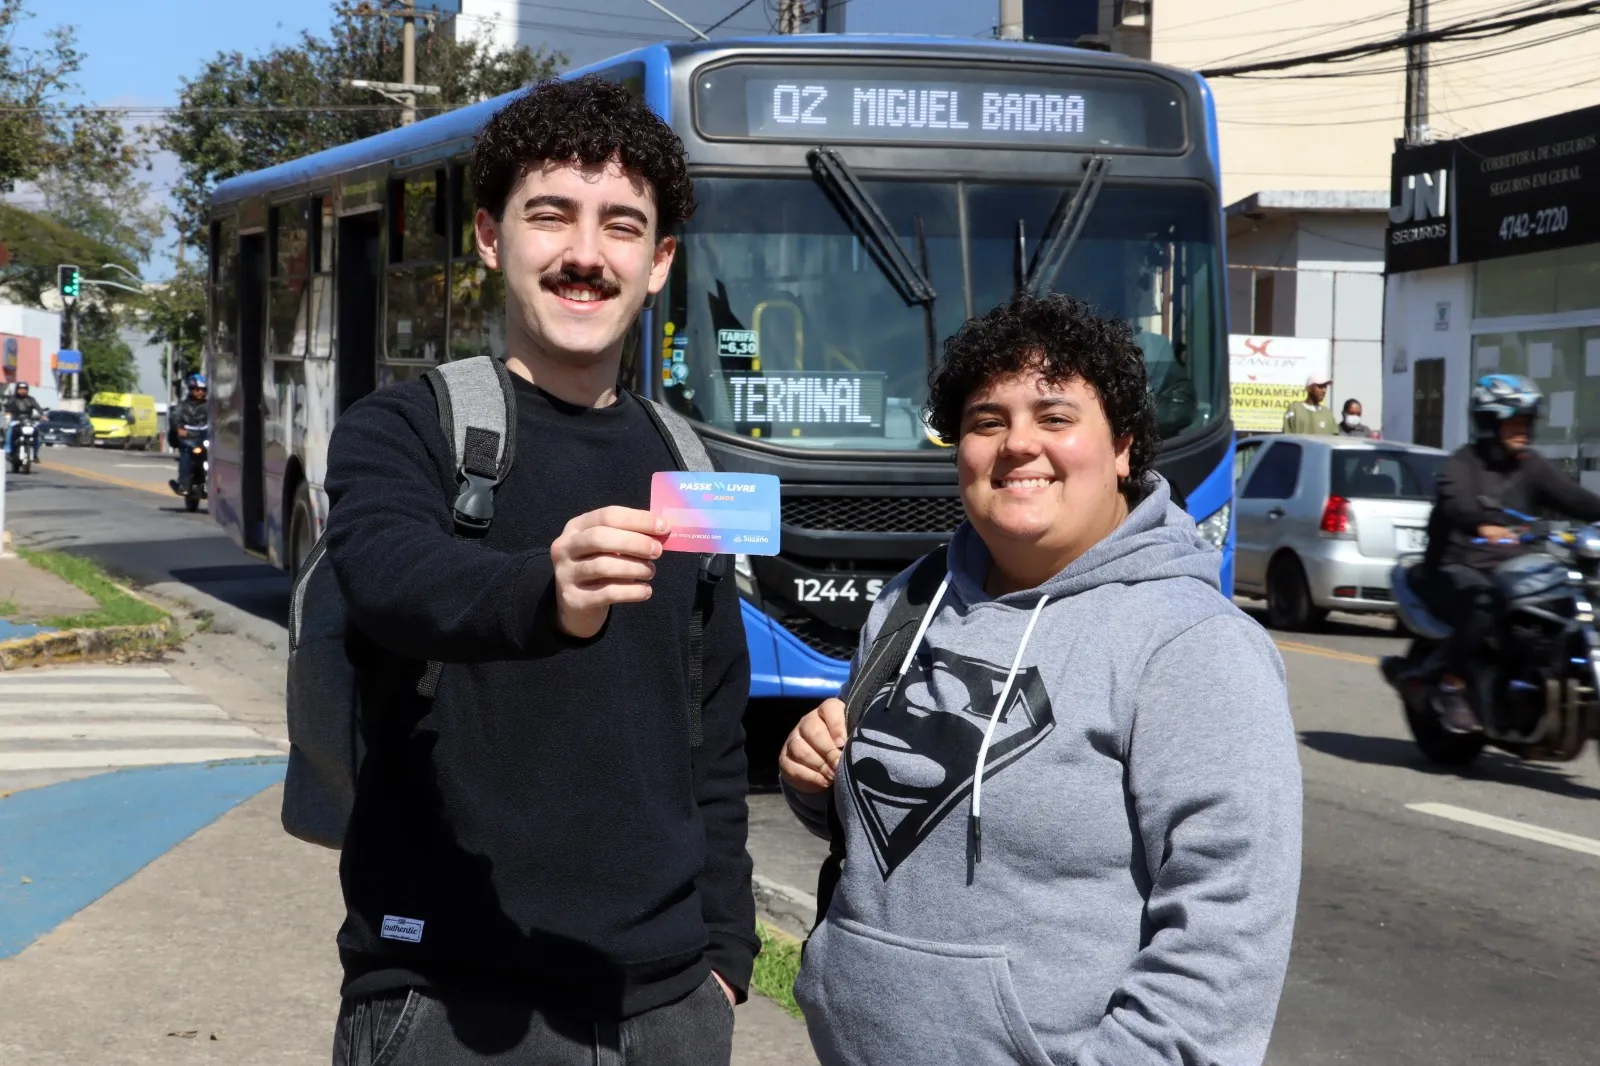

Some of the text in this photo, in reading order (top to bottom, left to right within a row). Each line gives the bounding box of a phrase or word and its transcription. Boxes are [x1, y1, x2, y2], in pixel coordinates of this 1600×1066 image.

[773, 85, 1085, 132] 02 MIGUEL BADRA
[1537, 144, 1550, 160] DE
[1551, 134, 1598, 156] SEGUROS
[1489, 165, 1582, 197] SEGUROS EM GERAL
[1388, 169, 1447, 224] JN
[1391, 224, 1447, 245] SEGUROS
[1498, 206, 1569, 240] 4742-2720
[720, 331, 756, 342] TARIFA
[730, 377, 871, 423] TERMINAL
[679, 483, 757, 493] PASSE LIVRE
[793, 578, 859, 601] 1244
[384, 924, 418, 934] authentic
